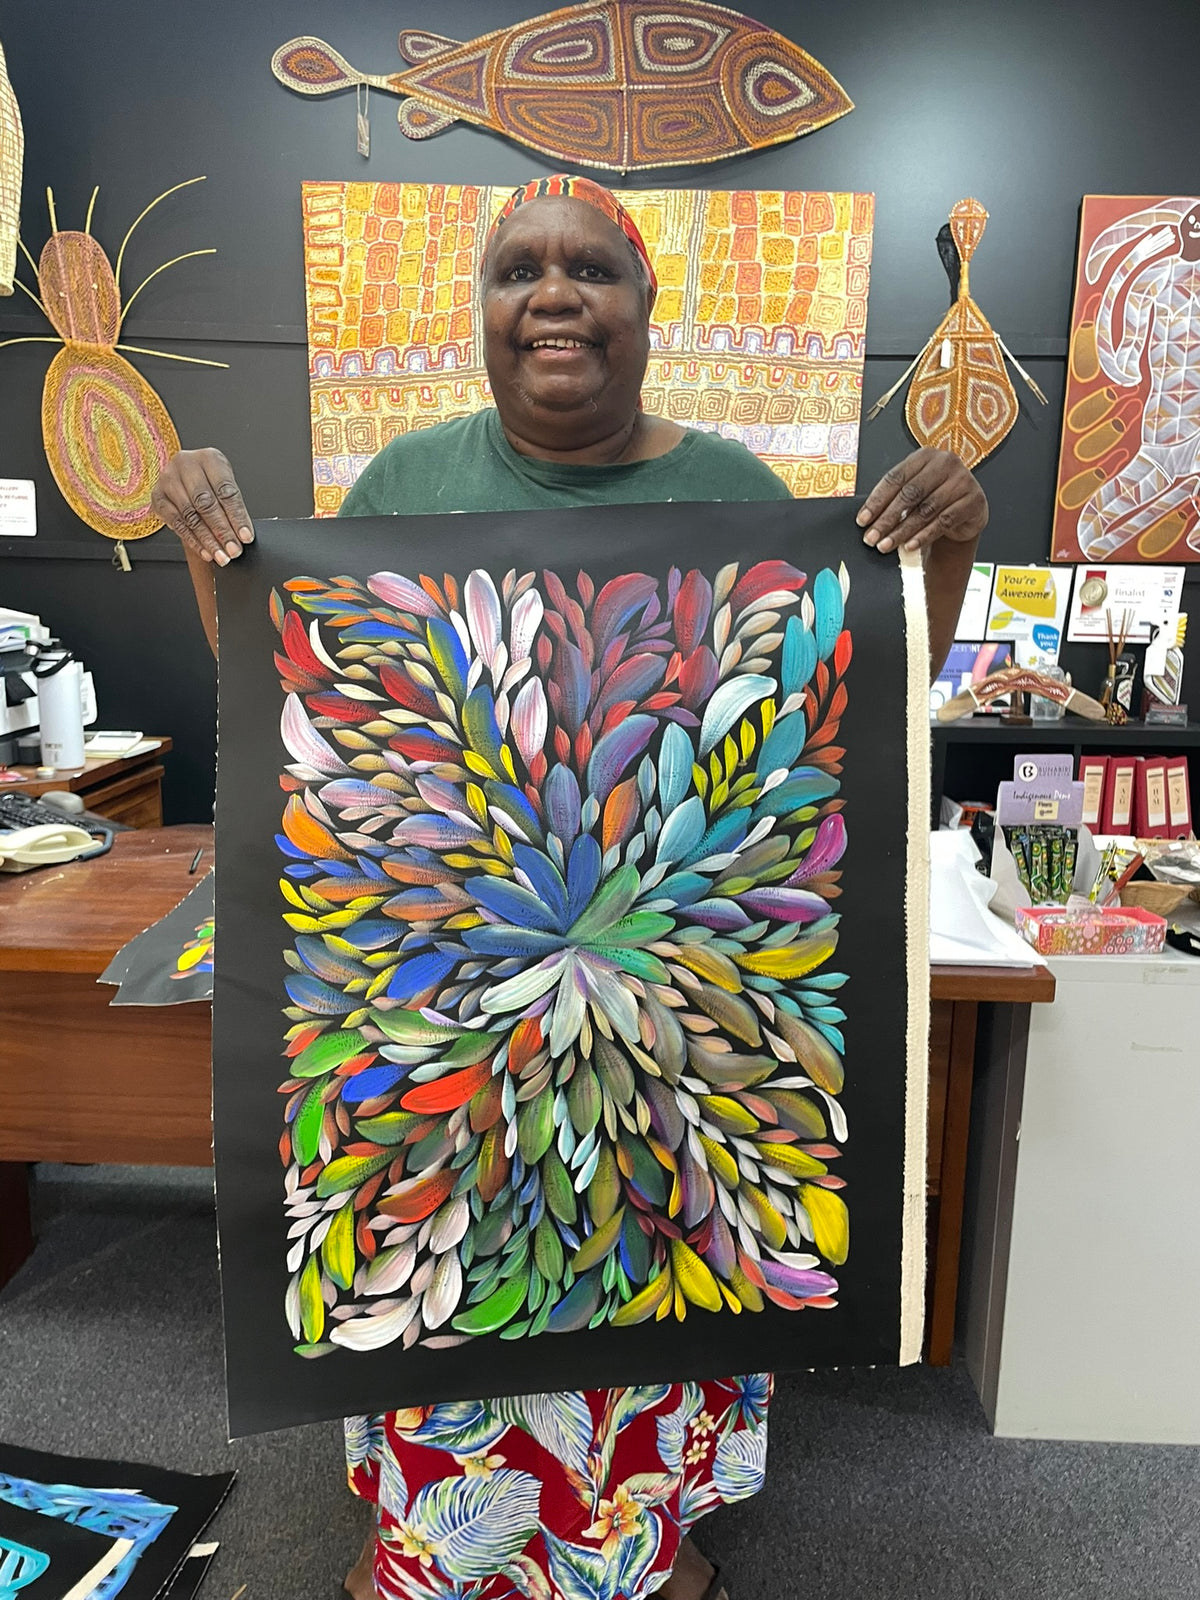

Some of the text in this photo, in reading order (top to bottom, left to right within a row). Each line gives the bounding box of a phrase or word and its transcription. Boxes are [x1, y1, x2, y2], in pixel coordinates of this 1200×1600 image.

[1004, 575, 1036, 585] You're
[1000, 588, 1050, 599] Awesome
[1037, 632, 1058, 641] Thank
